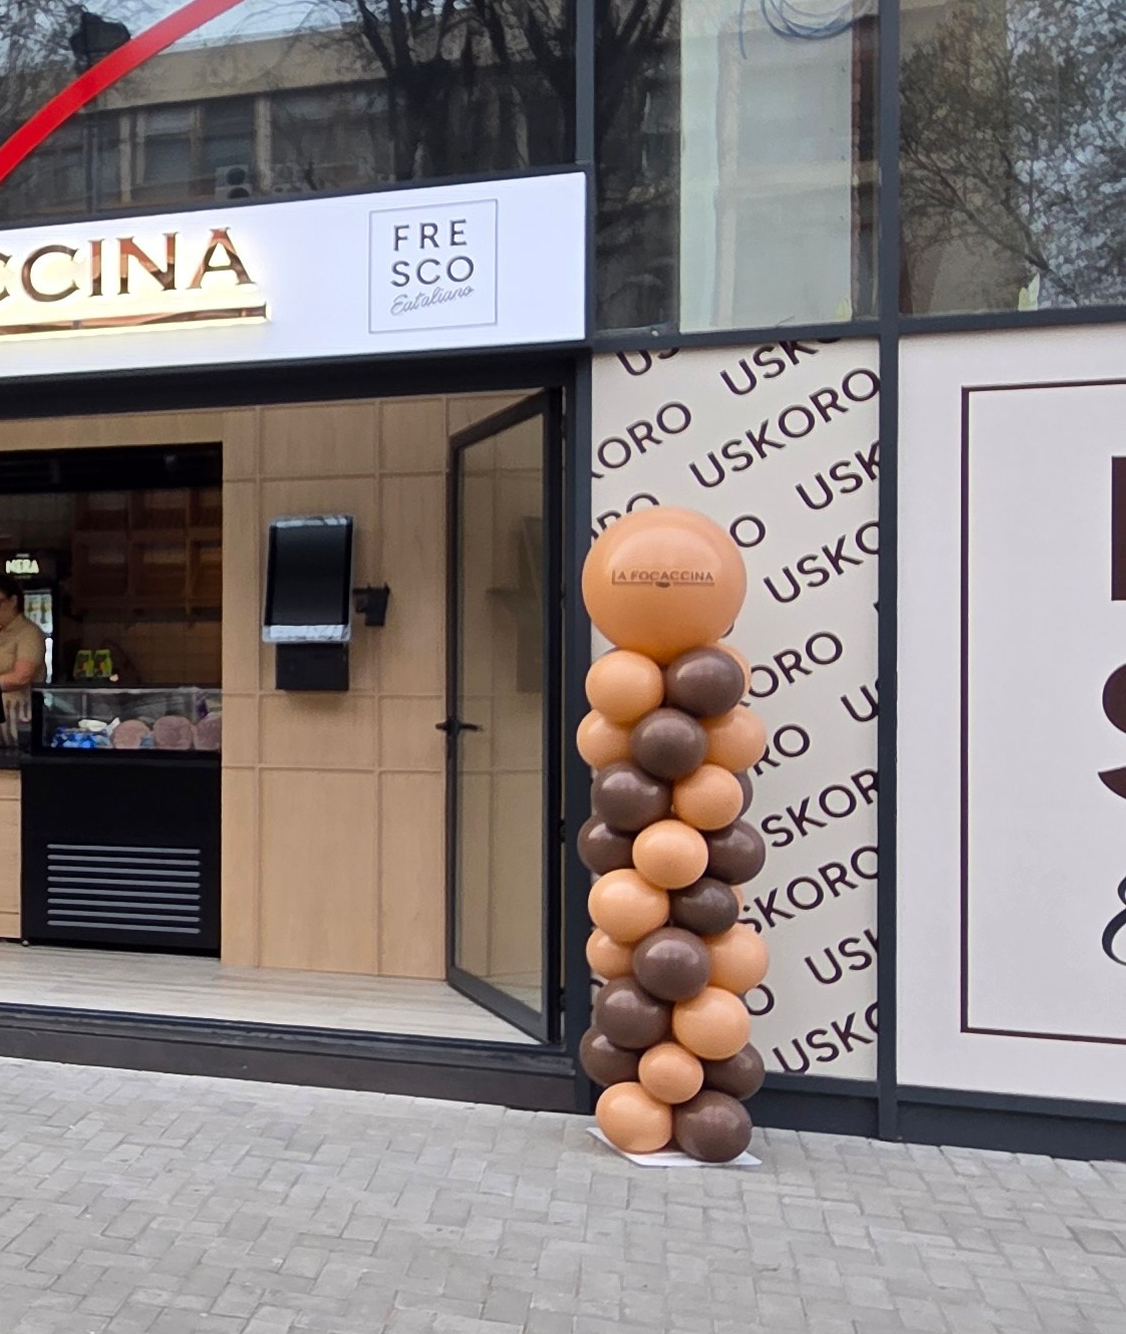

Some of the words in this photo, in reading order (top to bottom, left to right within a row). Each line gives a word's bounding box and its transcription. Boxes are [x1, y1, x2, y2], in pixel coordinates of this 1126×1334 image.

[393, 218, 467, 252] FRE
[390, 255, 475, 288] SCO
[389, 285, 475, 316] Eataliano
[688, 368, 880, 488] USKORO
[630, 571, 715, 581] FOCACCINA
